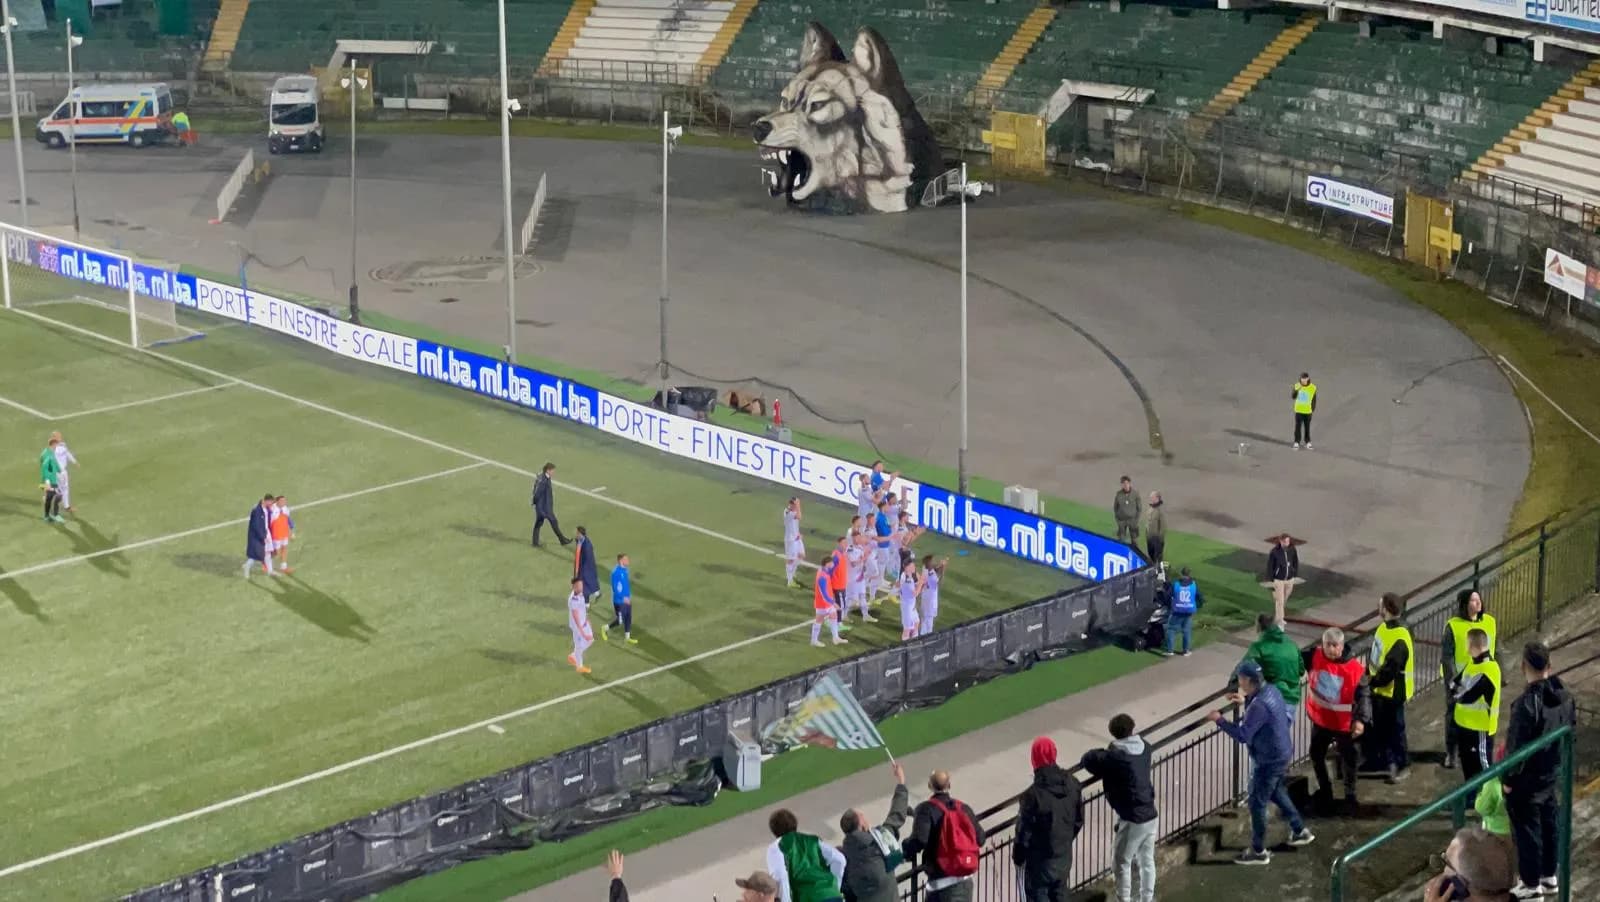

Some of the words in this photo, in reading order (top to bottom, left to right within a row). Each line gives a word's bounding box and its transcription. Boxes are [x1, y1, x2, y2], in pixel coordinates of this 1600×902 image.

[1309, 180, 1327, 200] GR
[1328, 187, 1393, 214] INFRASTRUTTURE
[200, 283, 257, 320] PORTE
[269, 301, 339, 349] FINESTRE
[352, 330, 413, 368] SCALE
[420, 346, 477, 389] mi.ba.
[480, 362, 537, 407] mi.ba.
[539, 379, 597, 426] mi.ba.
[602, 399, 671, 447] PORTE
[692, 426, 812, 487] FINESTRE
[924, 495, 1007, 550] mi.ba.
[1012, 519, 1098, 579] mi.ba.
[1180, 590, 1191, 602] 02
